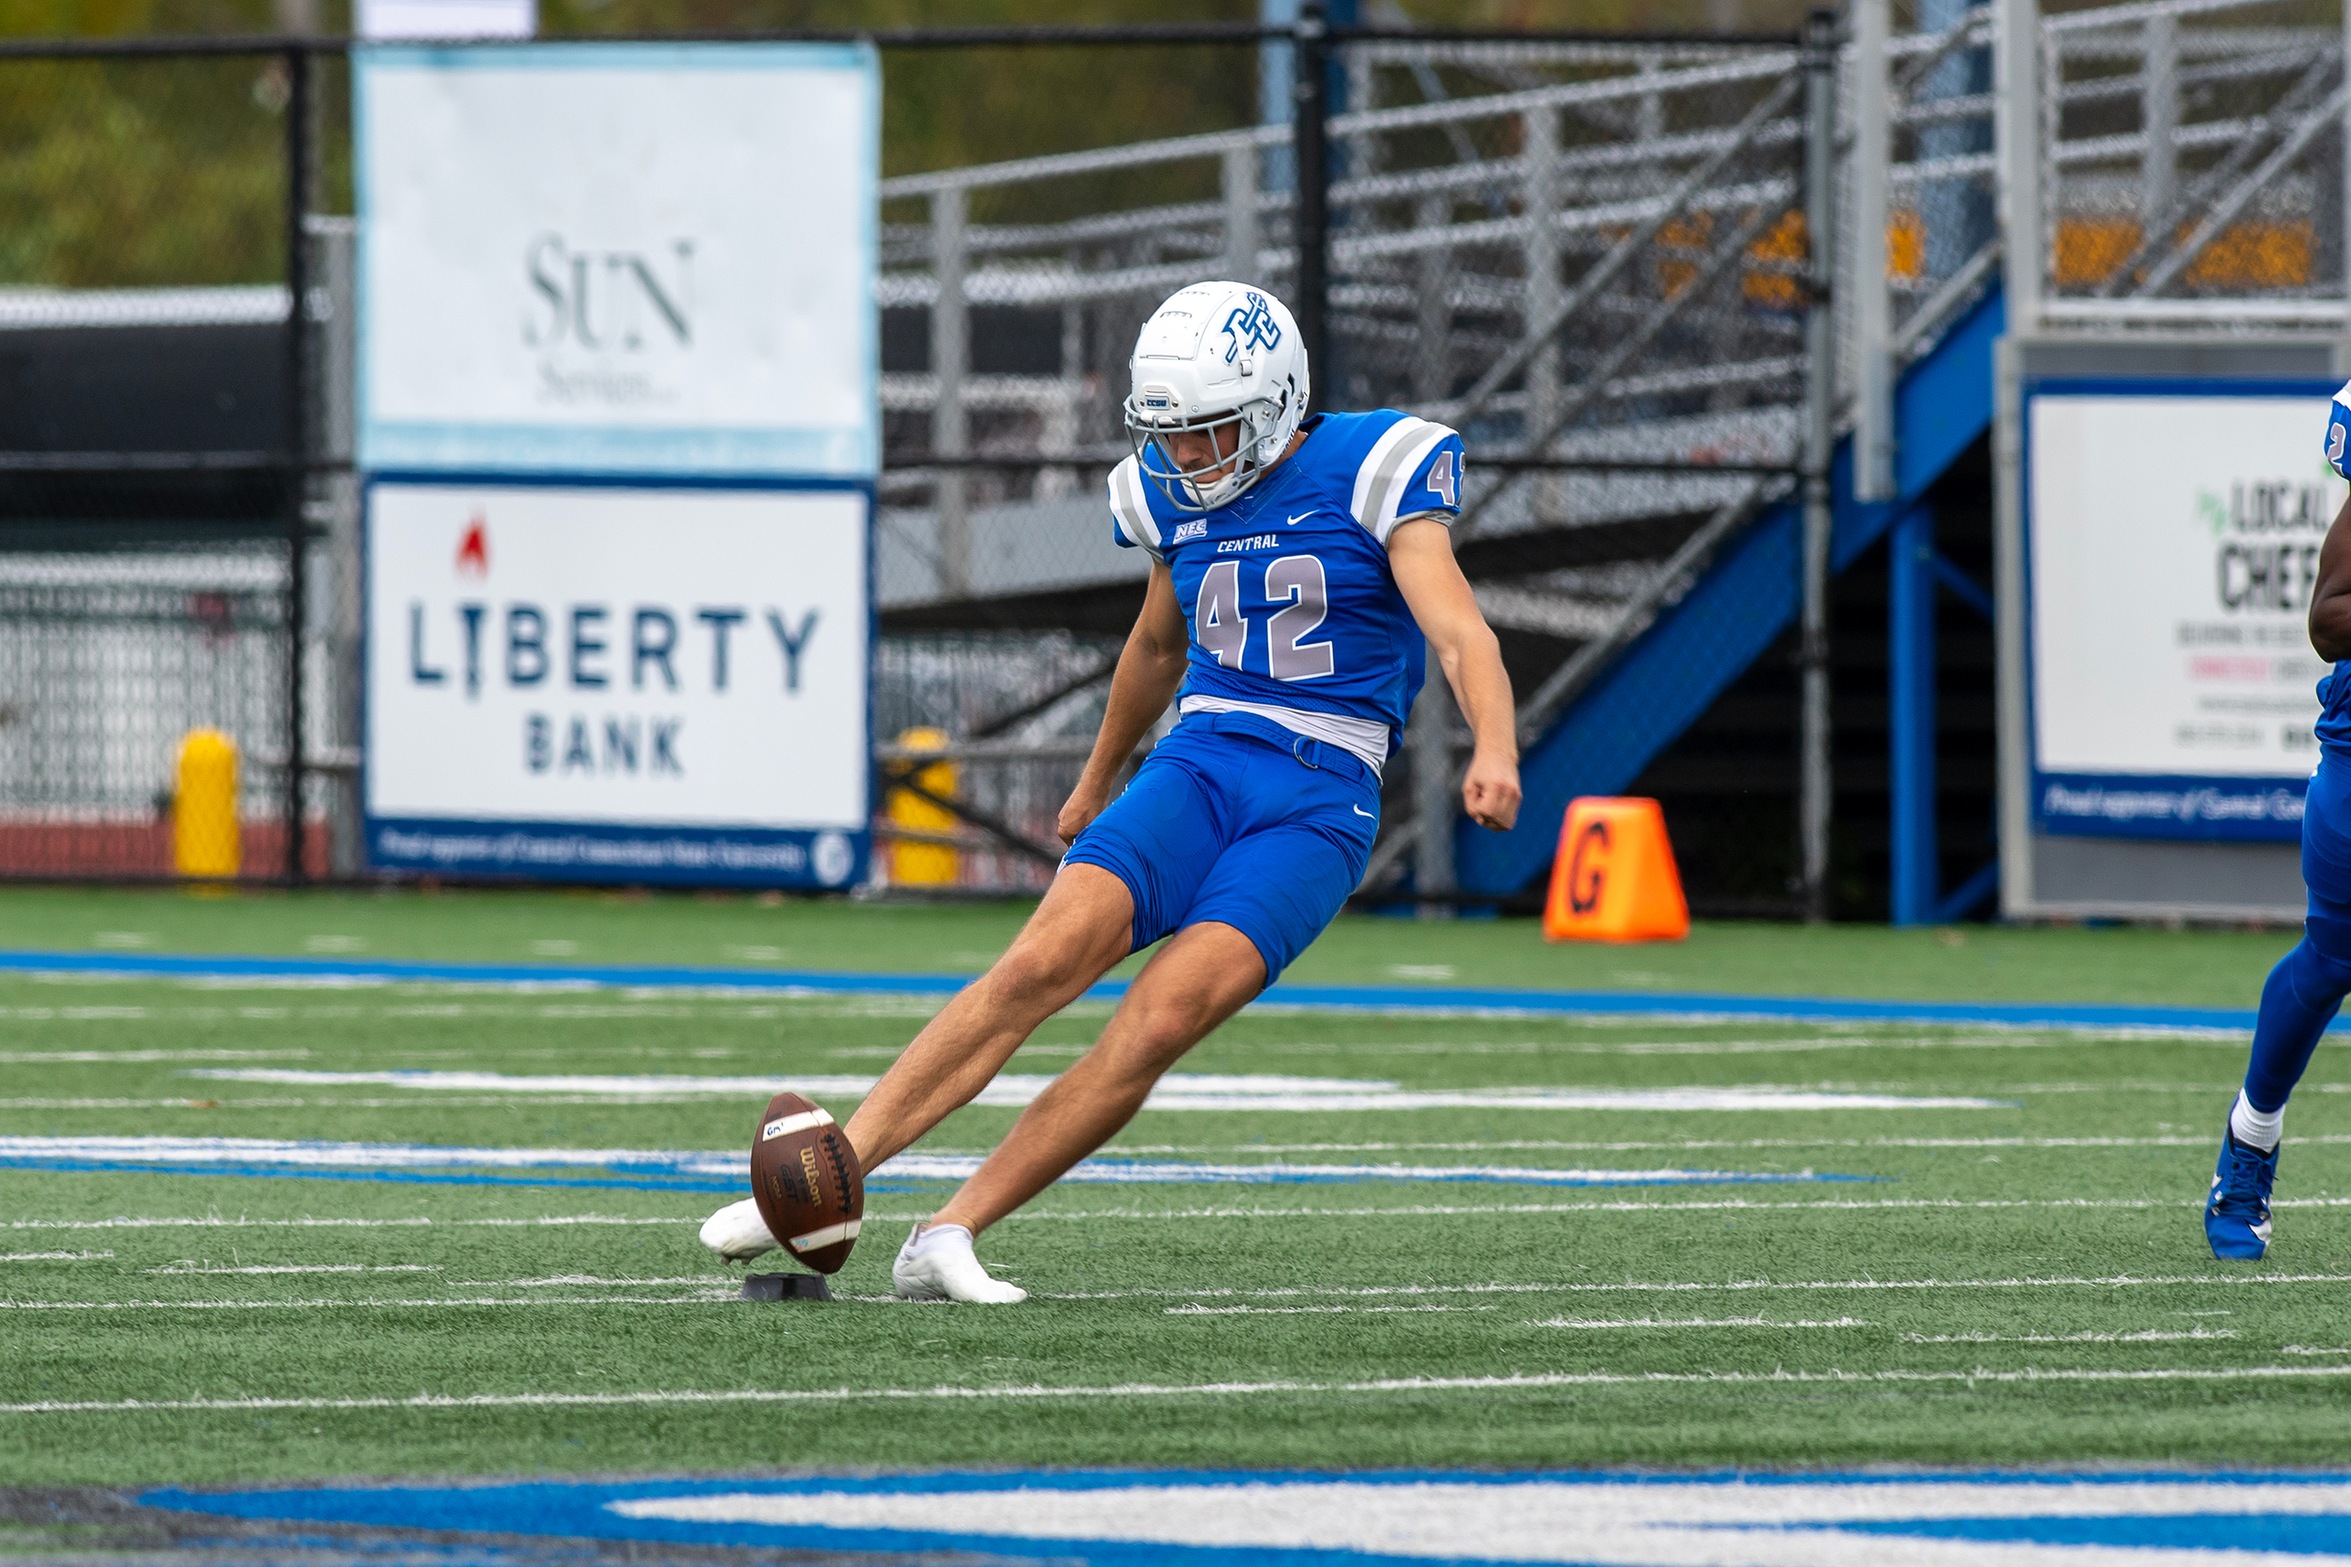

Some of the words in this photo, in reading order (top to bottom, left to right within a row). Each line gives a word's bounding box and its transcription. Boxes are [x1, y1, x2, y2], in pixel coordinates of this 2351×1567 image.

[520, 230, 697, 352] SUN
[1174, 518, 1207, 541] NEC
[2229, 481, 2329, 532] LOCAL
[1217, 534, 1280, 553] CENTRAL
[1196, 554, 1334, 682] 42
[408, 600, 822, 704] LIBERTY
[526, 712, 684, 777] BANK
[1569, 820, 1609, 915] G
[800, 1146, 822, 1209] Wilson
